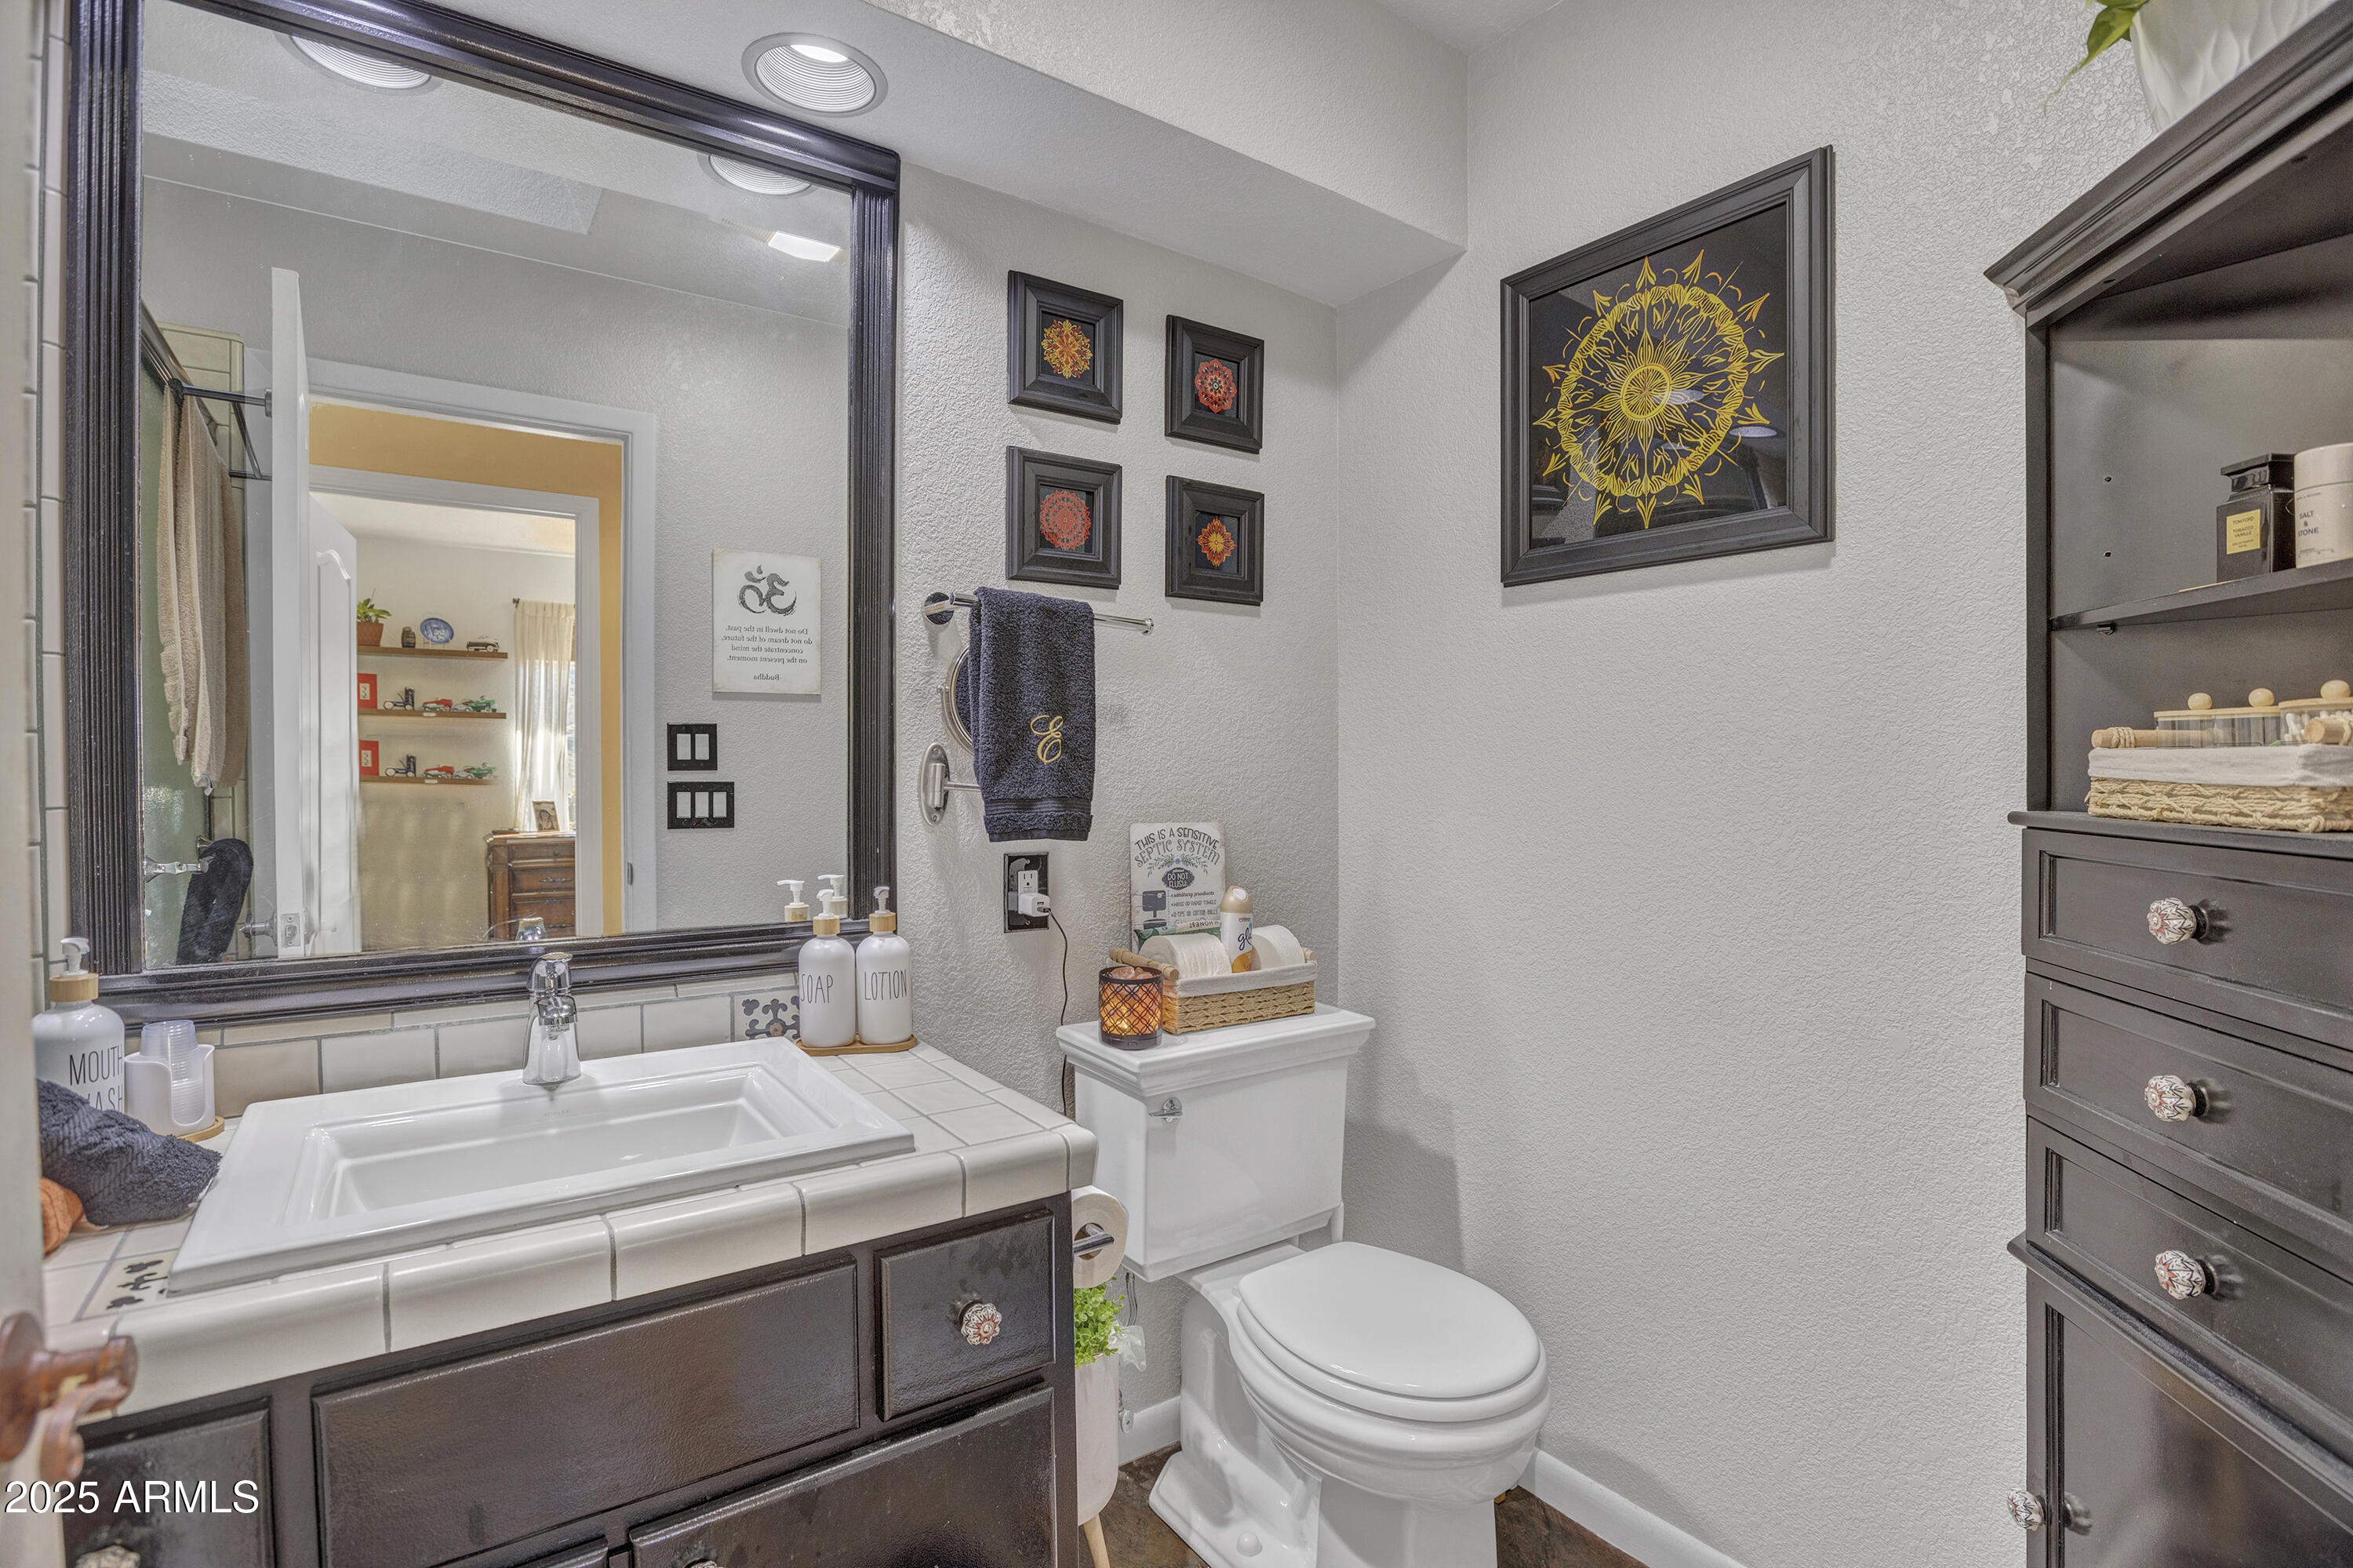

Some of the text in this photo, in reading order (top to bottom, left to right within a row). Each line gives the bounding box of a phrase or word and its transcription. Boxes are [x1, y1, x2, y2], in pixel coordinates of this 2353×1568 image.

[2299, 510, 2314, 519] SALT
[2298, 527, 2318, 537] STONE
[1030, 715, 1064, 765] E
[1135, 828, 1219, 850] THIS IS A SENSITIVE
[1135, 839, 1220, 867] SEPTIC SYSTEM
[800, 973, 833, 1003] SOAP
[864, 969, 907, 1001] LOTION
[70, 1043, 122, 1086] MOUTH
[88, 1083, 122, 1111] ASH
